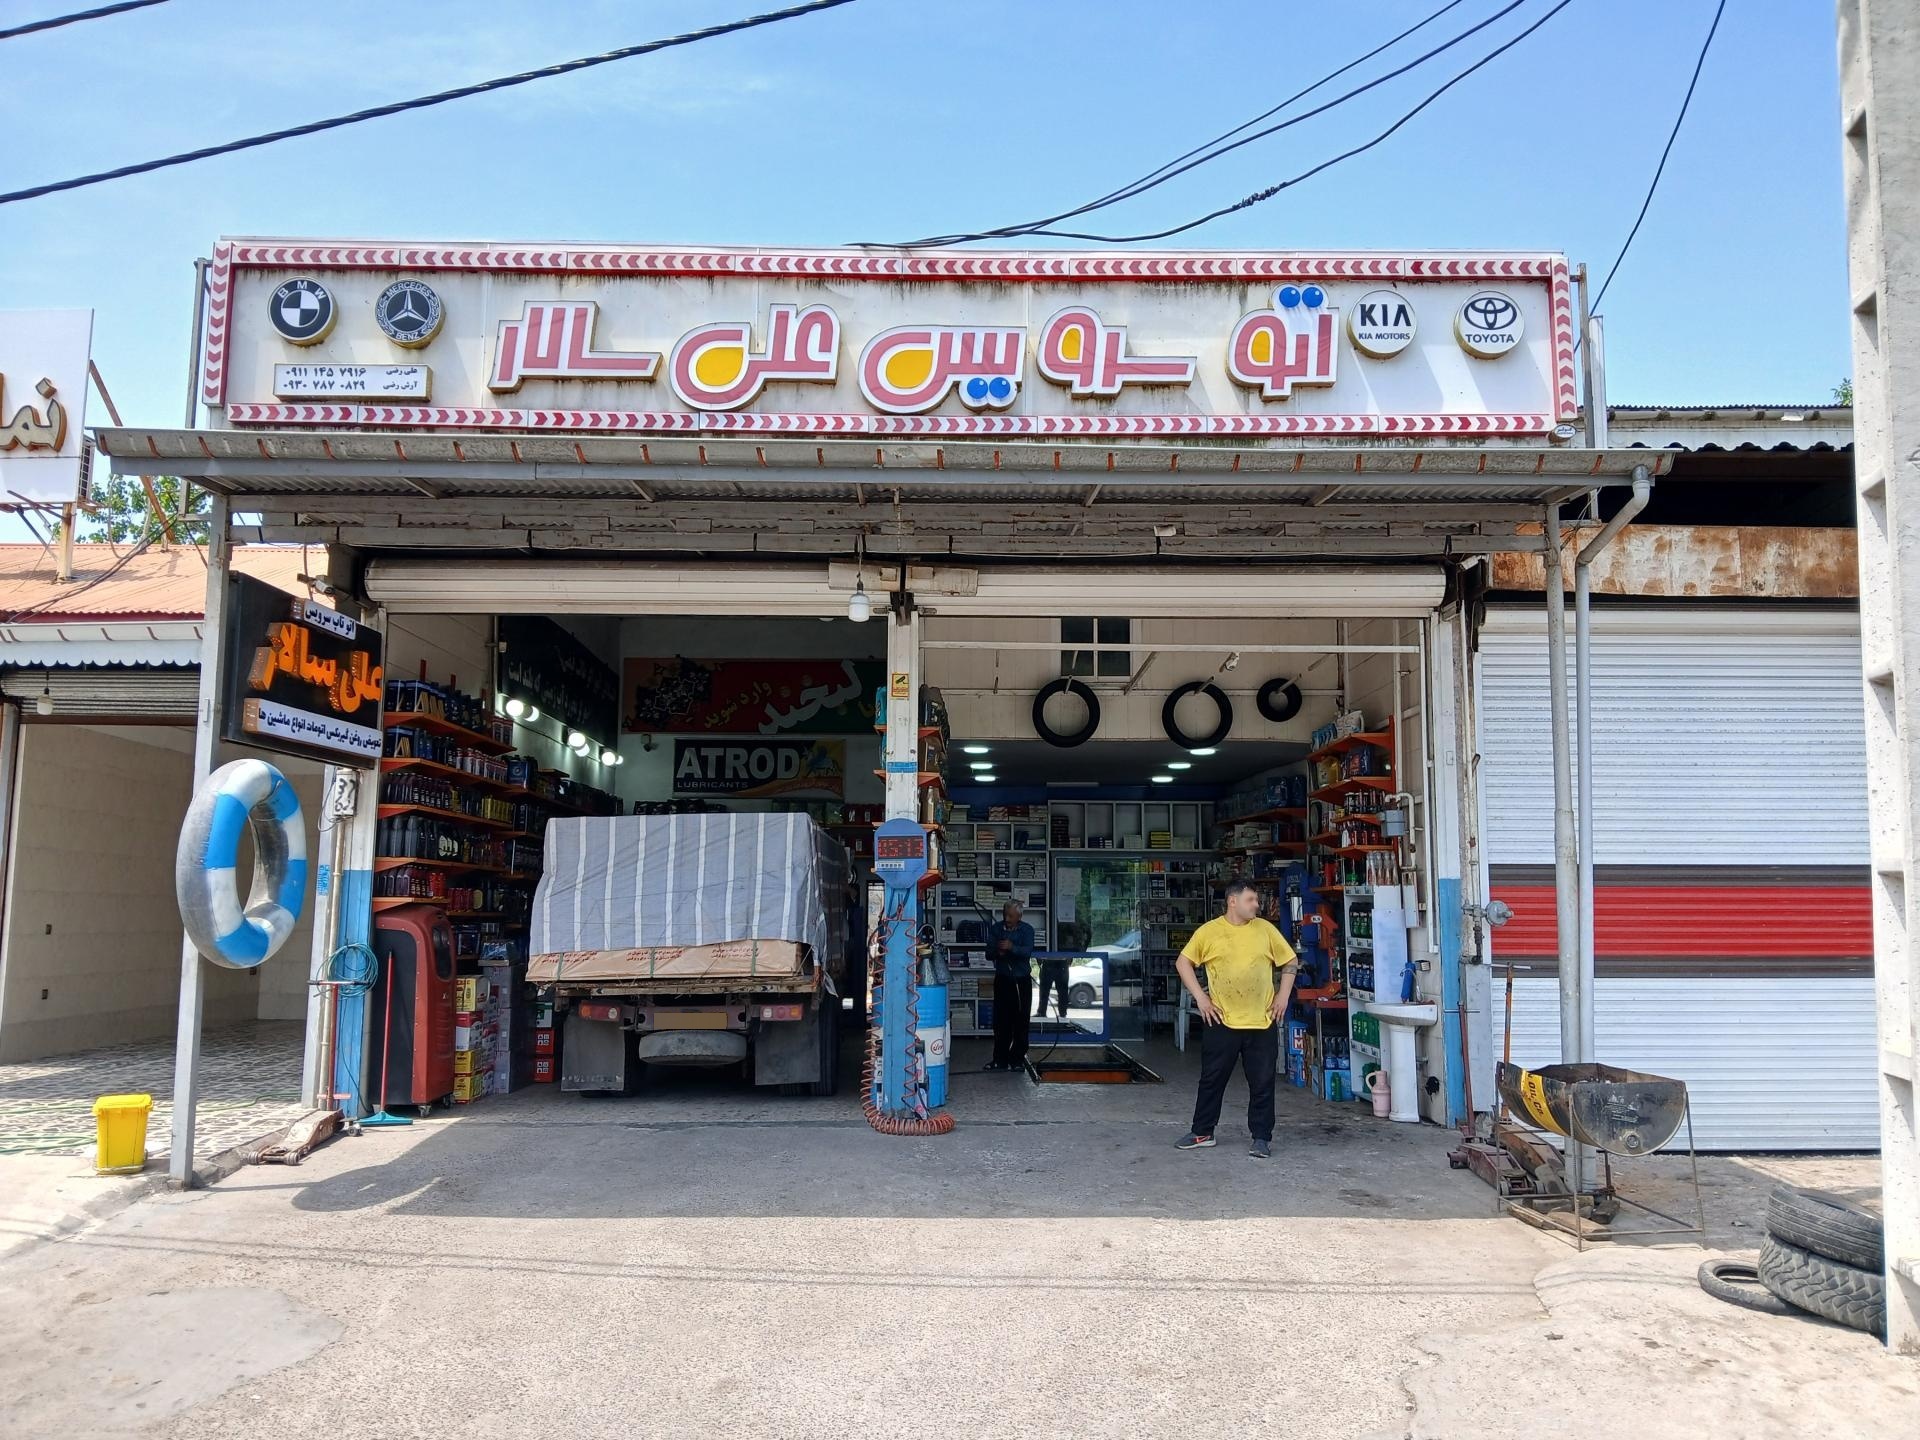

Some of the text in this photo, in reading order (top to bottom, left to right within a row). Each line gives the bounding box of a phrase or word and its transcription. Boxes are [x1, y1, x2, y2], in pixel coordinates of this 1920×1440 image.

[277, 281, 327, 299] BMW
[386, 281, 432, 297] MERCEDES
[1359, 303, 1412, 327] KIA
[396, 331, 420, 341] BENZ
[1358, 332, 1411, 340] KIA MOTORS
[1465, 333, 1515, 344] TOYOTA
[494, 285, 1336, 411] اتو سرویس علی سالار
[258, 622, 337, 690] سالار
[676, 747, 801, 780] ATROD
[677, 781, 749, 789] LUBRICANTS
